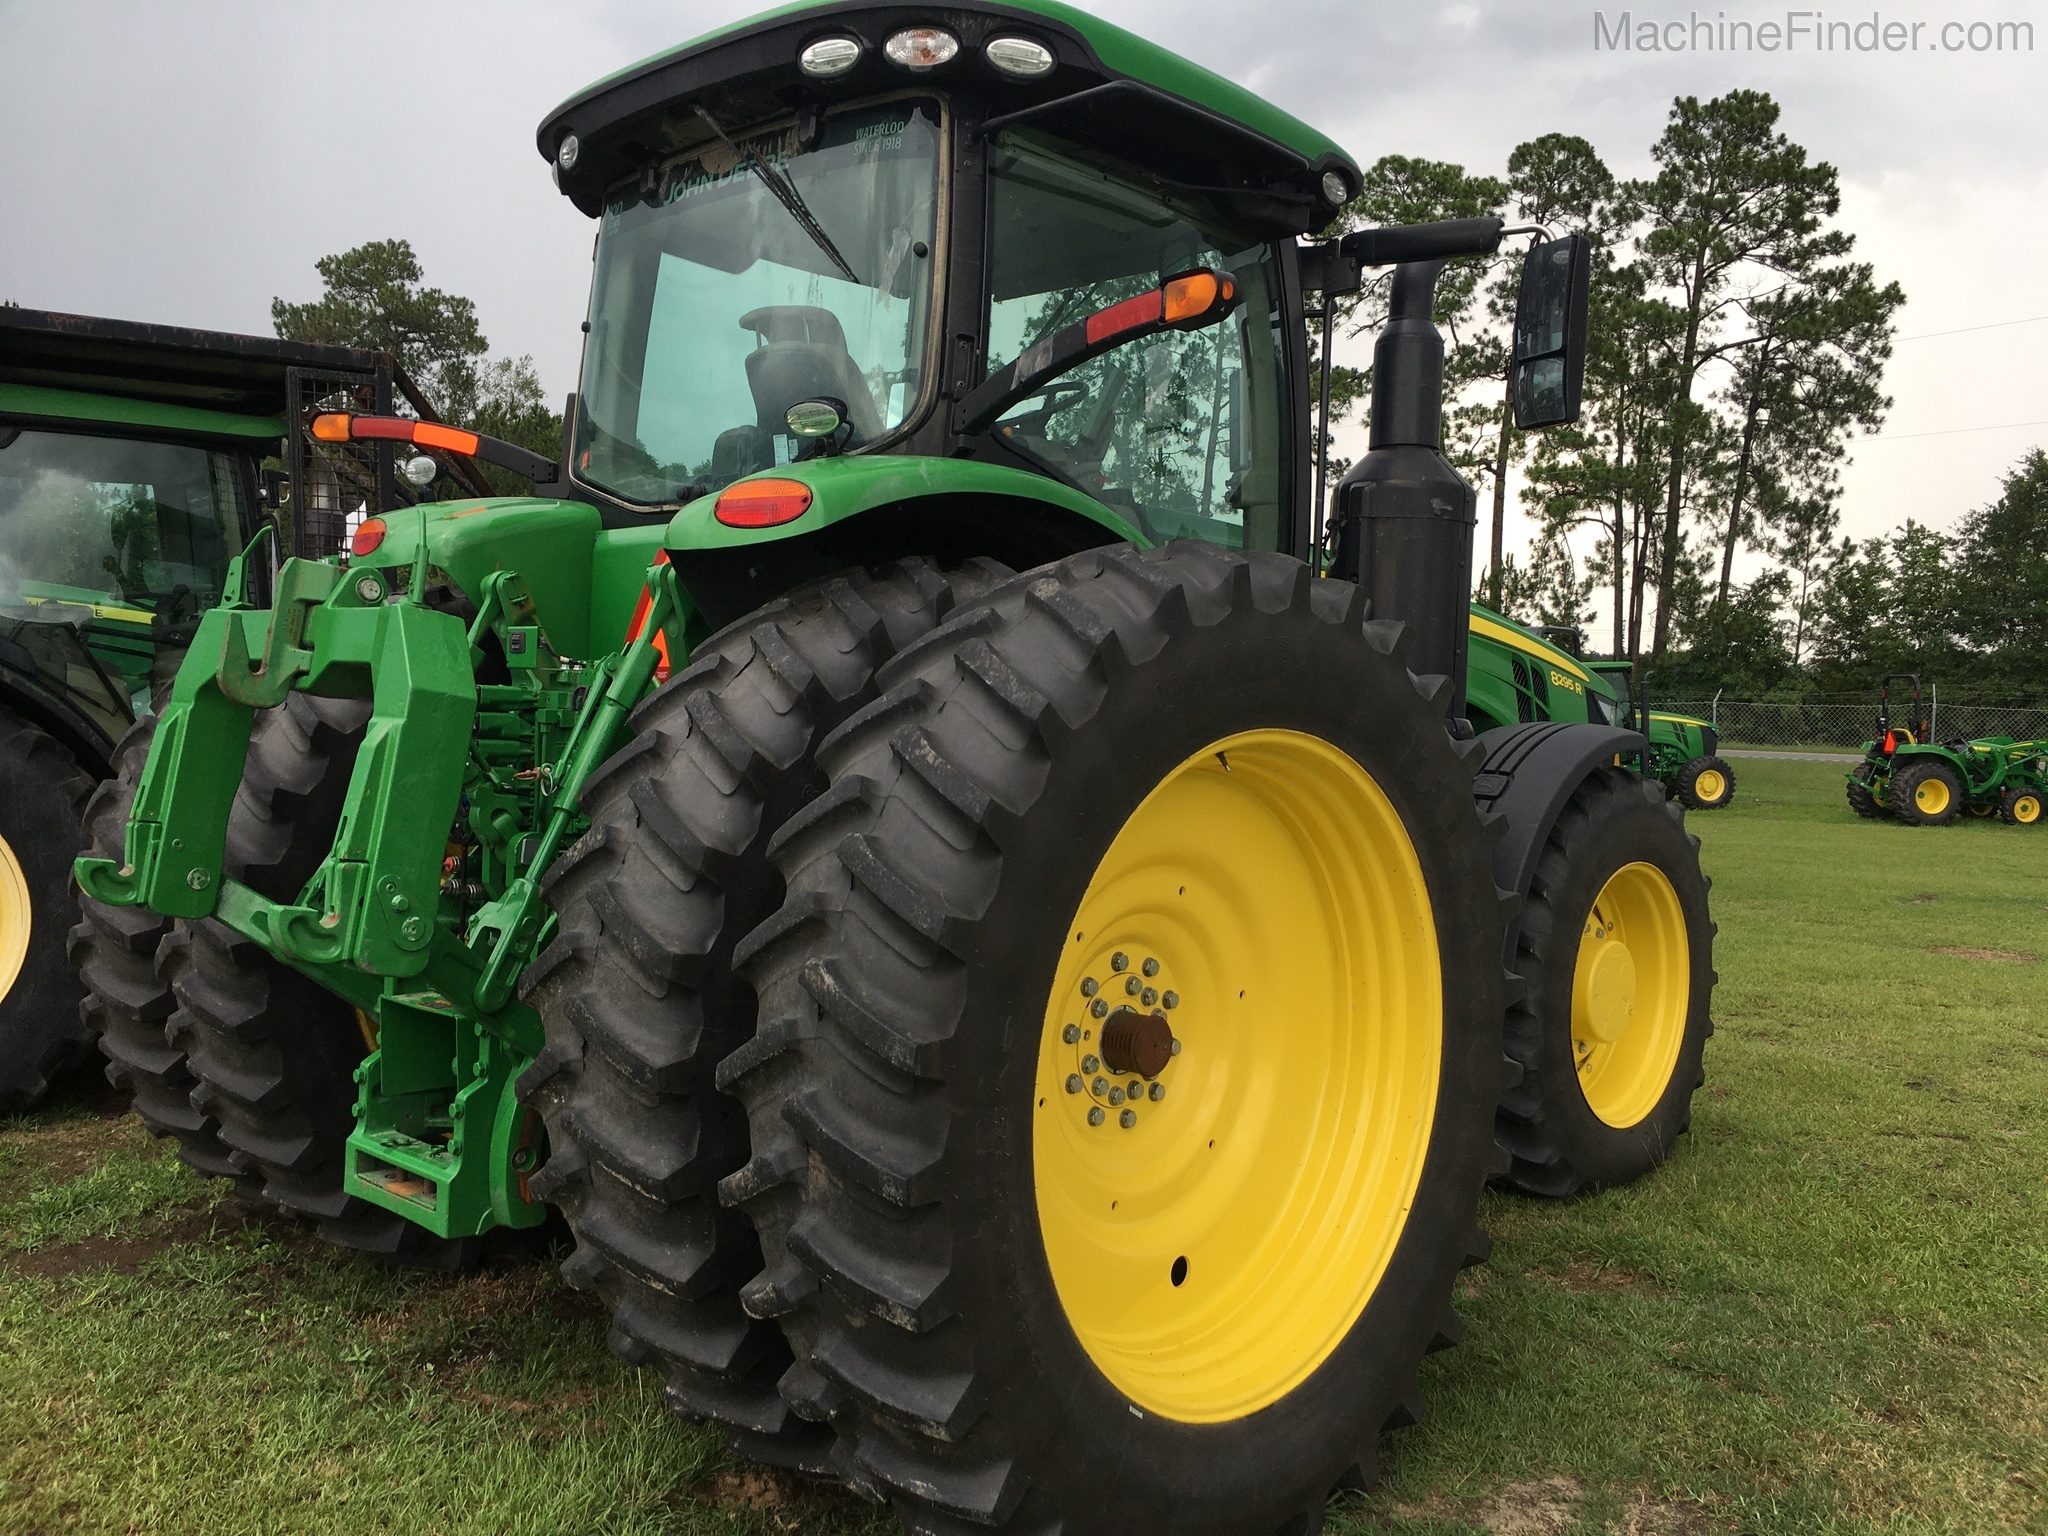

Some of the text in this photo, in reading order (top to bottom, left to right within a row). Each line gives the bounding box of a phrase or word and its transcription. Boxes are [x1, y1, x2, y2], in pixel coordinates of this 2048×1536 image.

[855, 121, 905, 140] WATERLOO
[853, 136, 902, 156] SINCE 1918
[663, 172, 715, 206] JOHN
[1550, 670, 1582, 695] 8295 R
